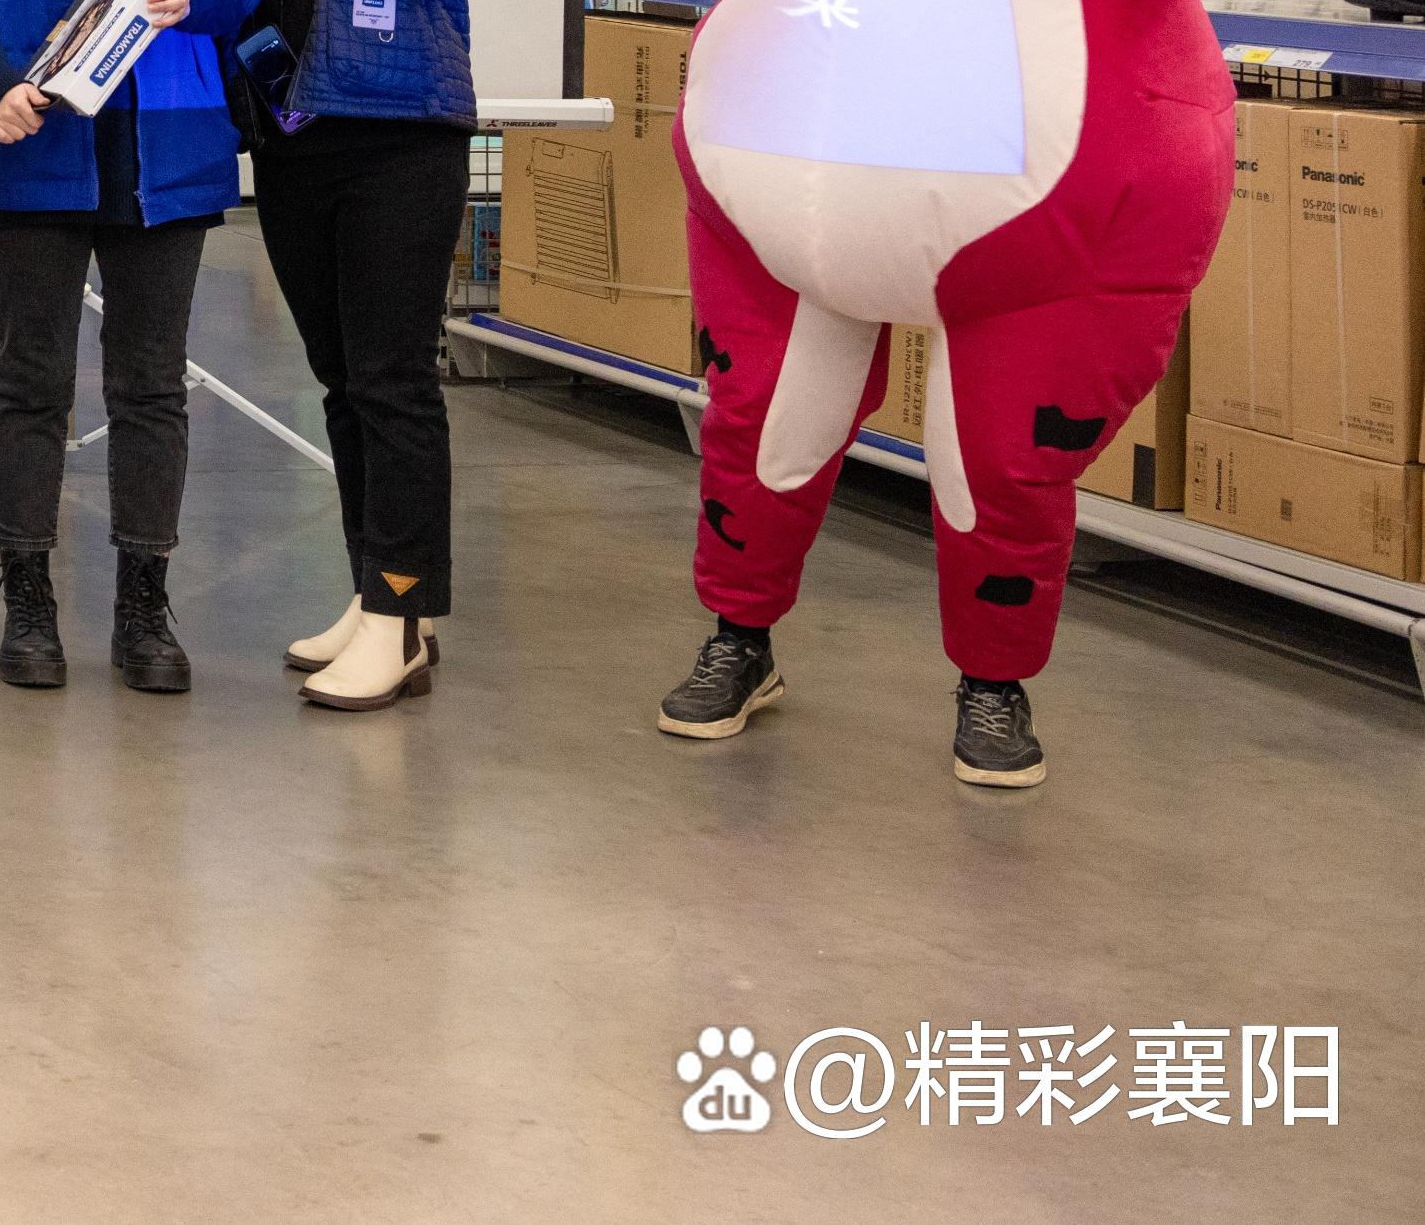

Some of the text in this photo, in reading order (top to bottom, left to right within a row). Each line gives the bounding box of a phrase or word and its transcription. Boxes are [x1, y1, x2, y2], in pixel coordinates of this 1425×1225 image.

[94, 23, 144, 80] TRAMONTINA
[913, 333, 925, 427] 远红外电暖器
